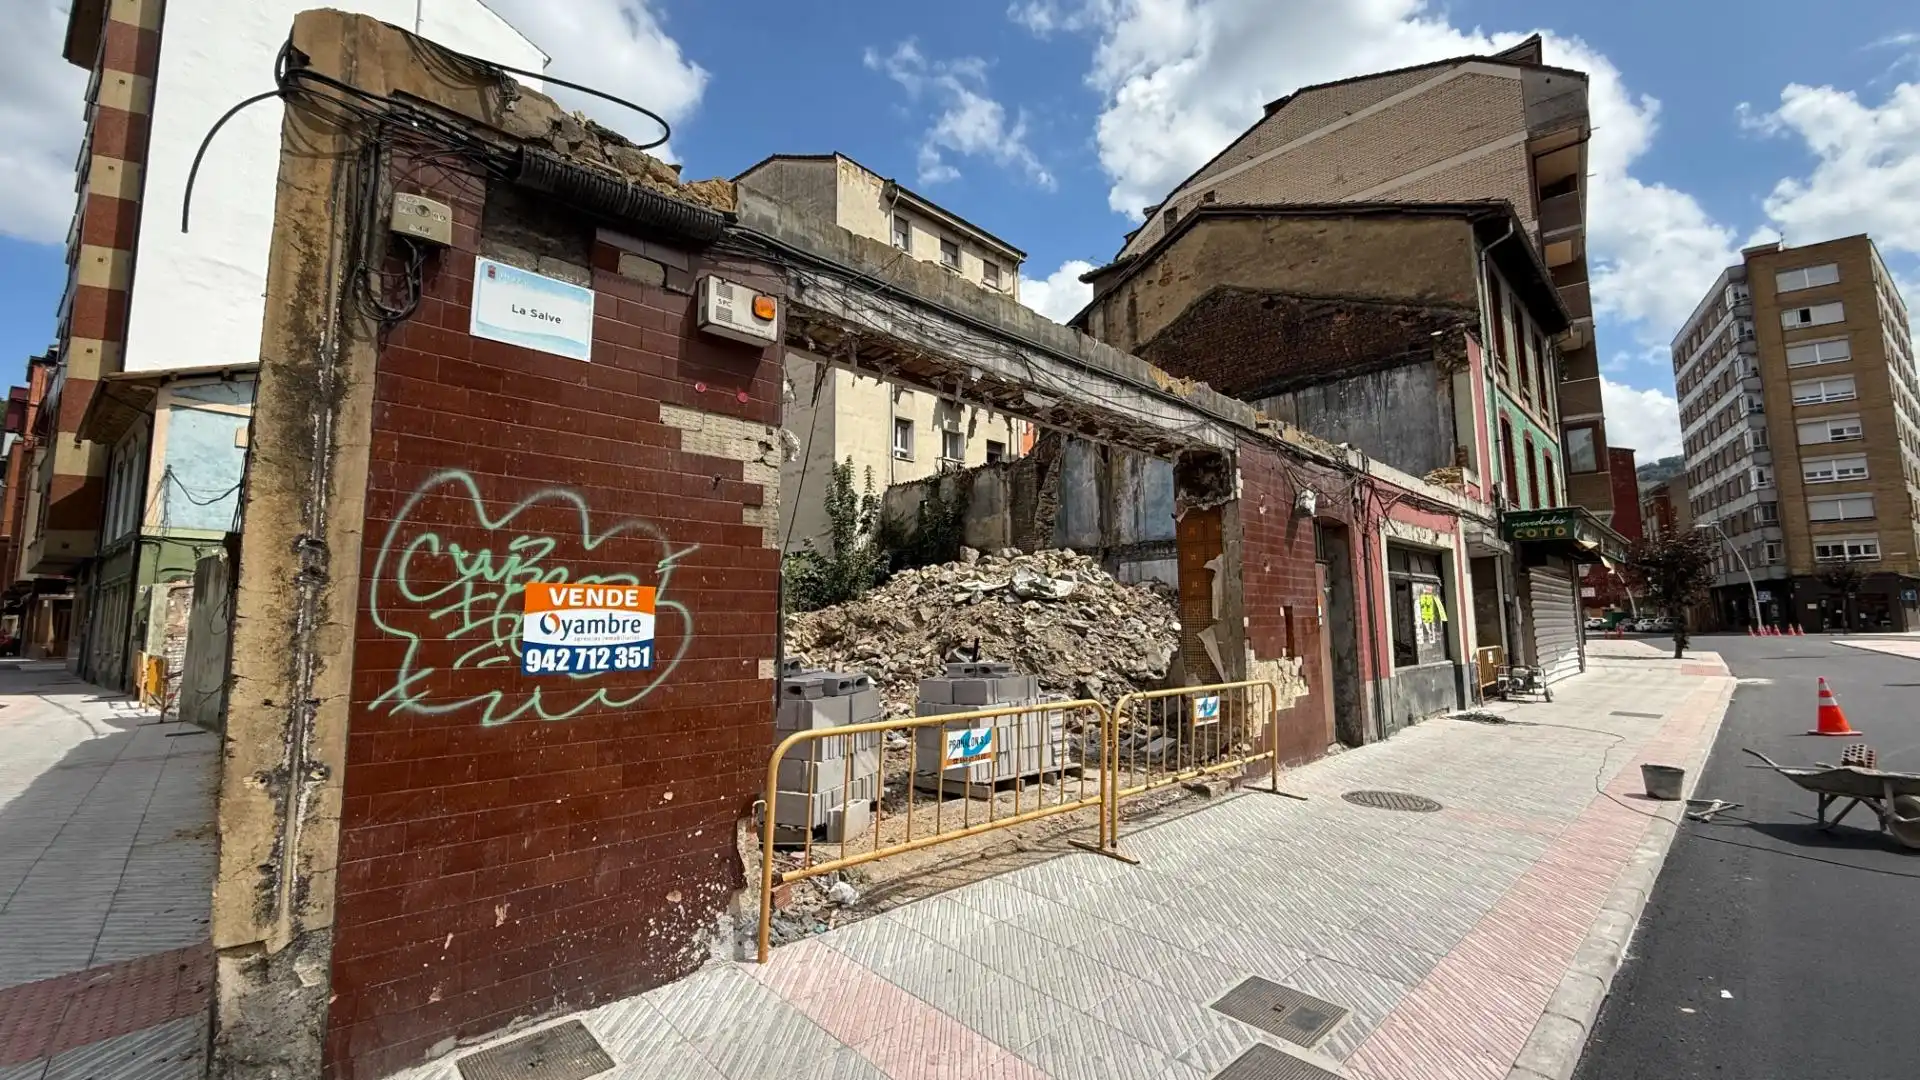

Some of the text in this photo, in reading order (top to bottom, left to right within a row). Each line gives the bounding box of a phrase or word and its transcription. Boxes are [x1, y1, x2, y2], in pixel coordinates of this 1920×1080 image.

[511, 304, 562, 324] La Salve
[1513, 526, 1567, 538] COTO
[548, 587, 640, 607] VENDE
[539, 612, 642, 641] Oyambre
[525, 646, 651, 673] 942 712 351
